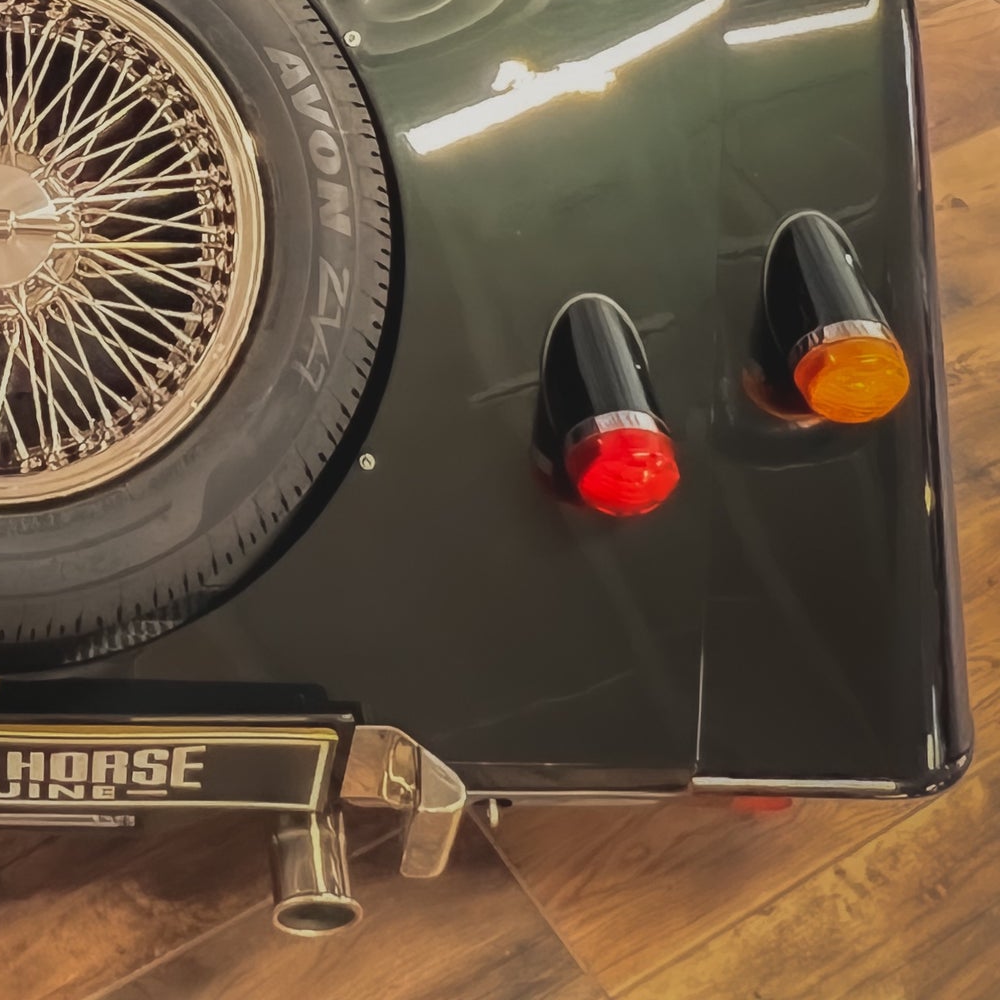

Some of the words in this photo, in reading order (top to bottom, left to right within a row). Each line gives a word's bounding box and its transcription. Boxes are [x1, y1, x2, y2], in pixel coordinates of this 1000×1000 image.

[264, 47, 352, 237] AVON
[291, 256, 350, 392] ZV7
[6, 745, 207, 789] HORSE
